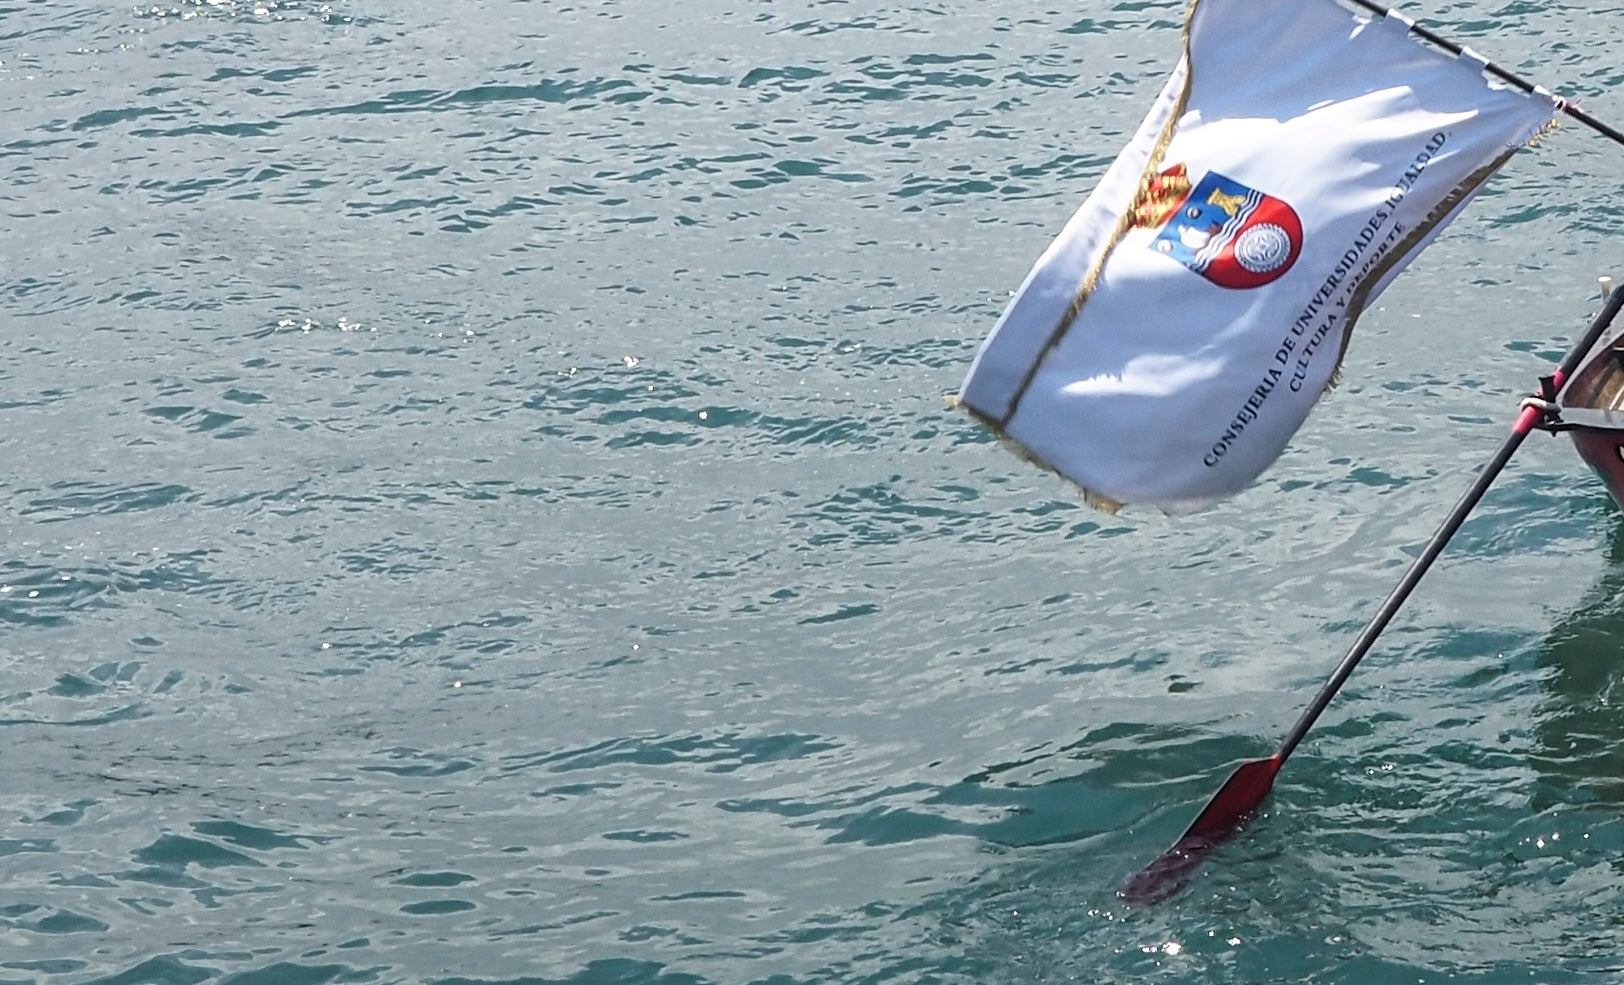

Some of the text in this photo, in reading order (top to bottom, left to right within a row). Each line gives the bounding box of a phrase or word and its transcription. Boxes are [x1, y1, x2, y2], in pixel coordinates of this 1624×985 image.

[1289, 221, 1405, 394] CULTURA Y DEPORTE
[1203, 367, 1283, 468] CONSEJERIA
[1275, 339, 1296, 367] DE
